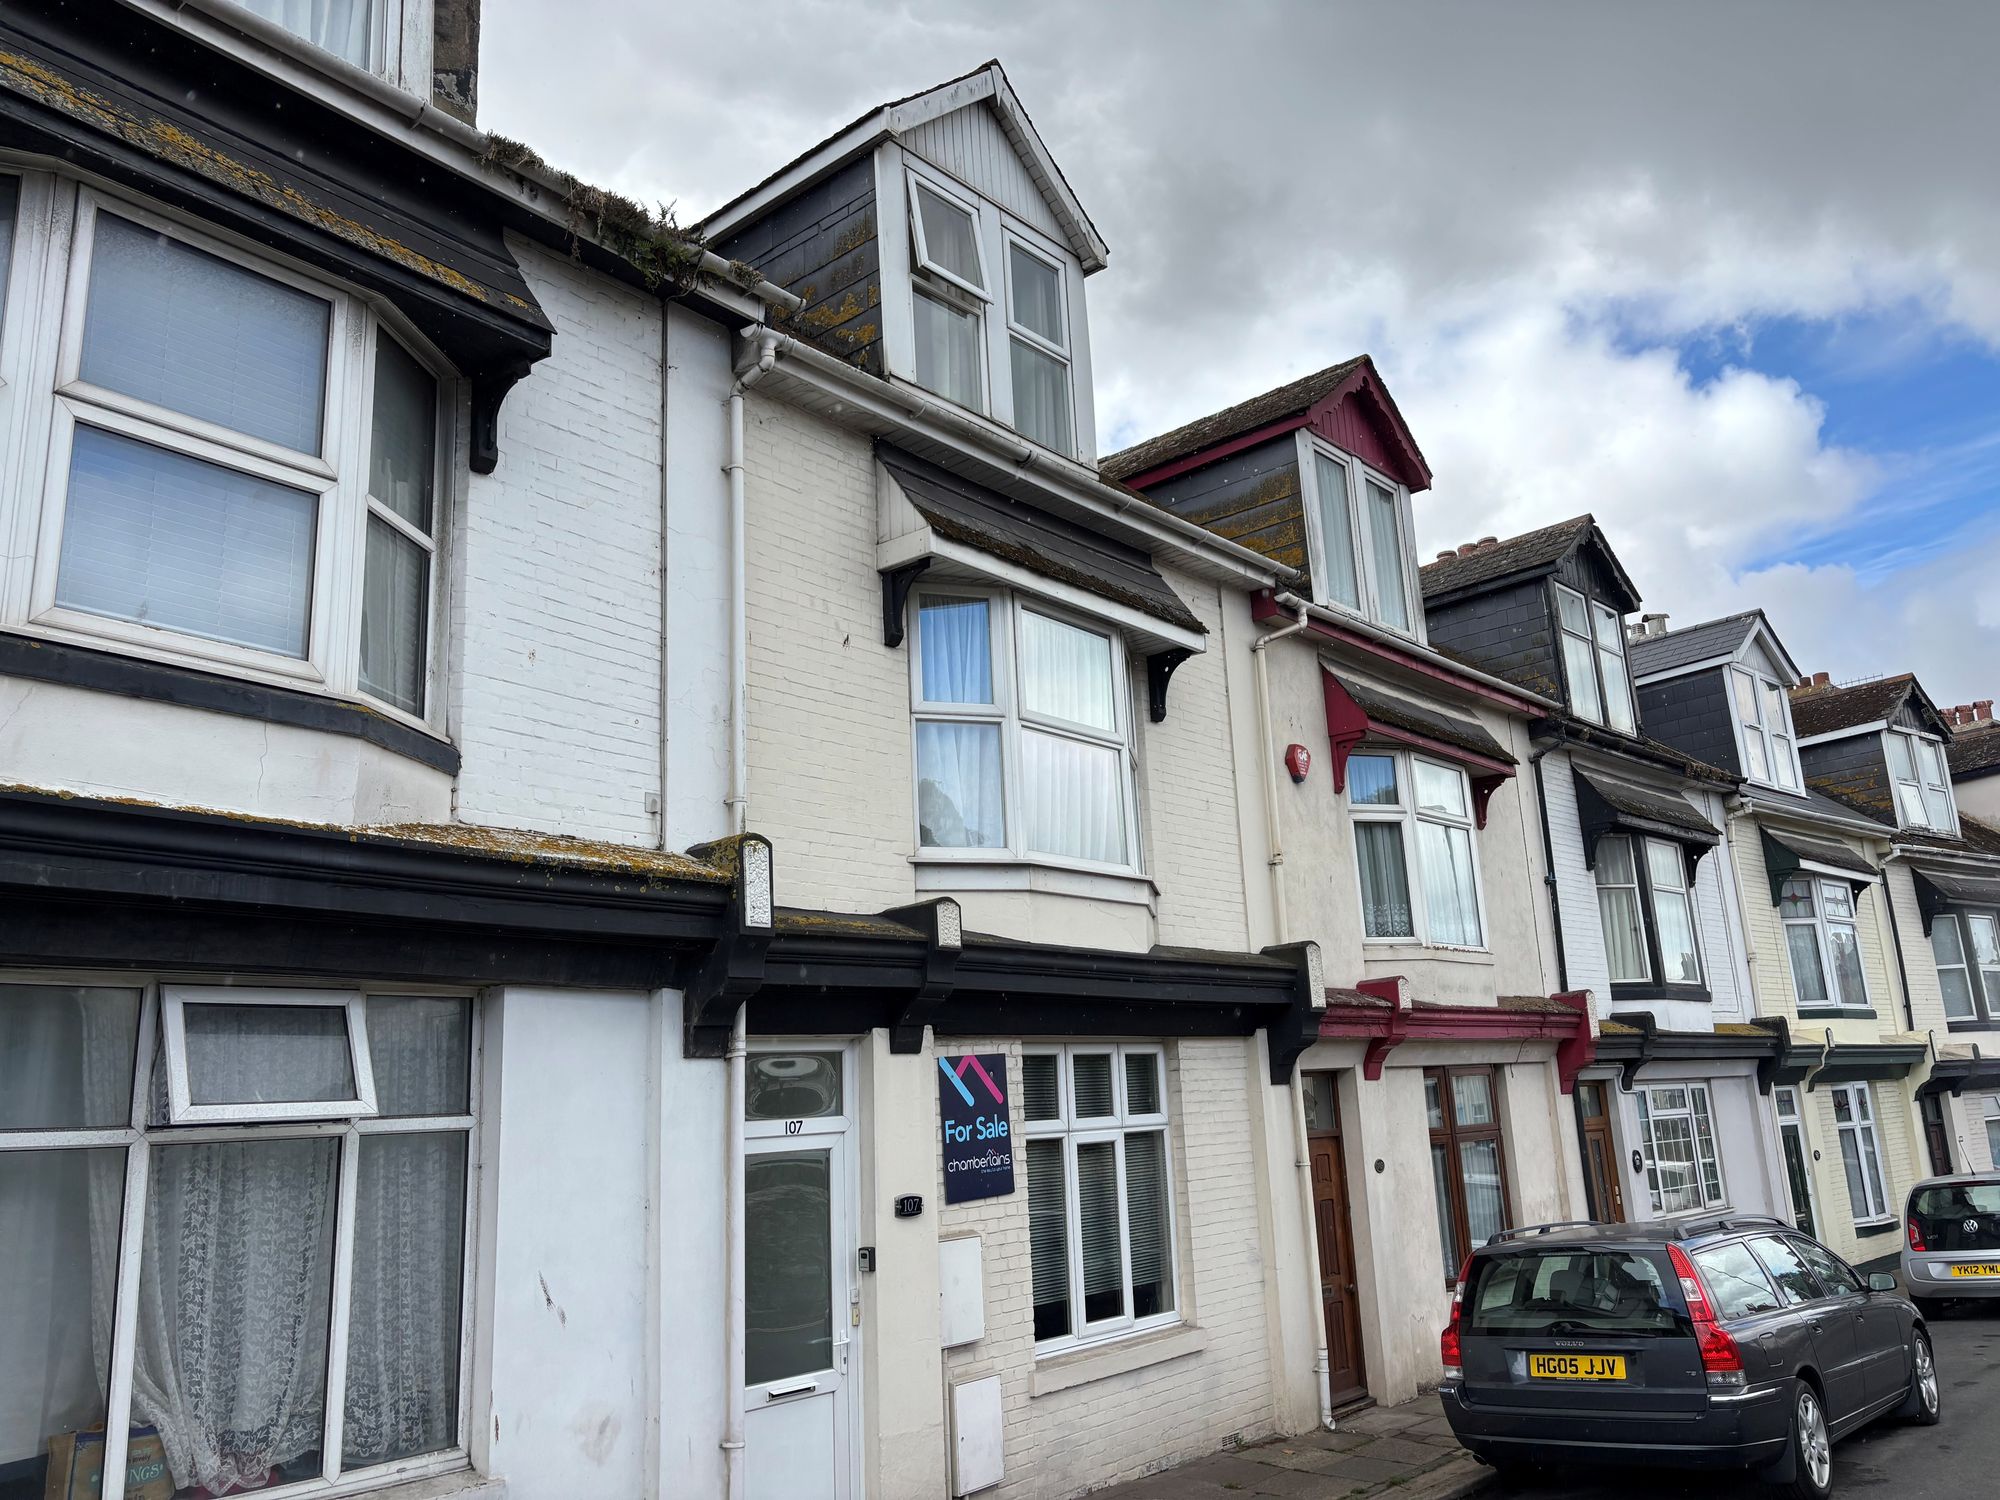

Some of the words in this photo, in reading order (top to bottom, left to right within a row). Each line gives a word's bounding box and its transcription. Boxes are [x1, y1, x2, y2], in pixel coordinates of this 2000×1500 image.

[785, 1120, 803, 1135] 107
[945, 1119, 973, 1144] For
[976, 1113, 1008, 1140] Sale
[947, 1153, 1011, 1172] chamberlains
[904, 1198, 920, 1212] 107
[1957, 1265, 1980, 1275] YK12
[1981, 1264, 2000, 1274] YML
[1536, 1357, 1579, 1375] HG05
[1584, 1358, 1616, 1376] JJV
[128, 1464, 161, 1483] NGS
